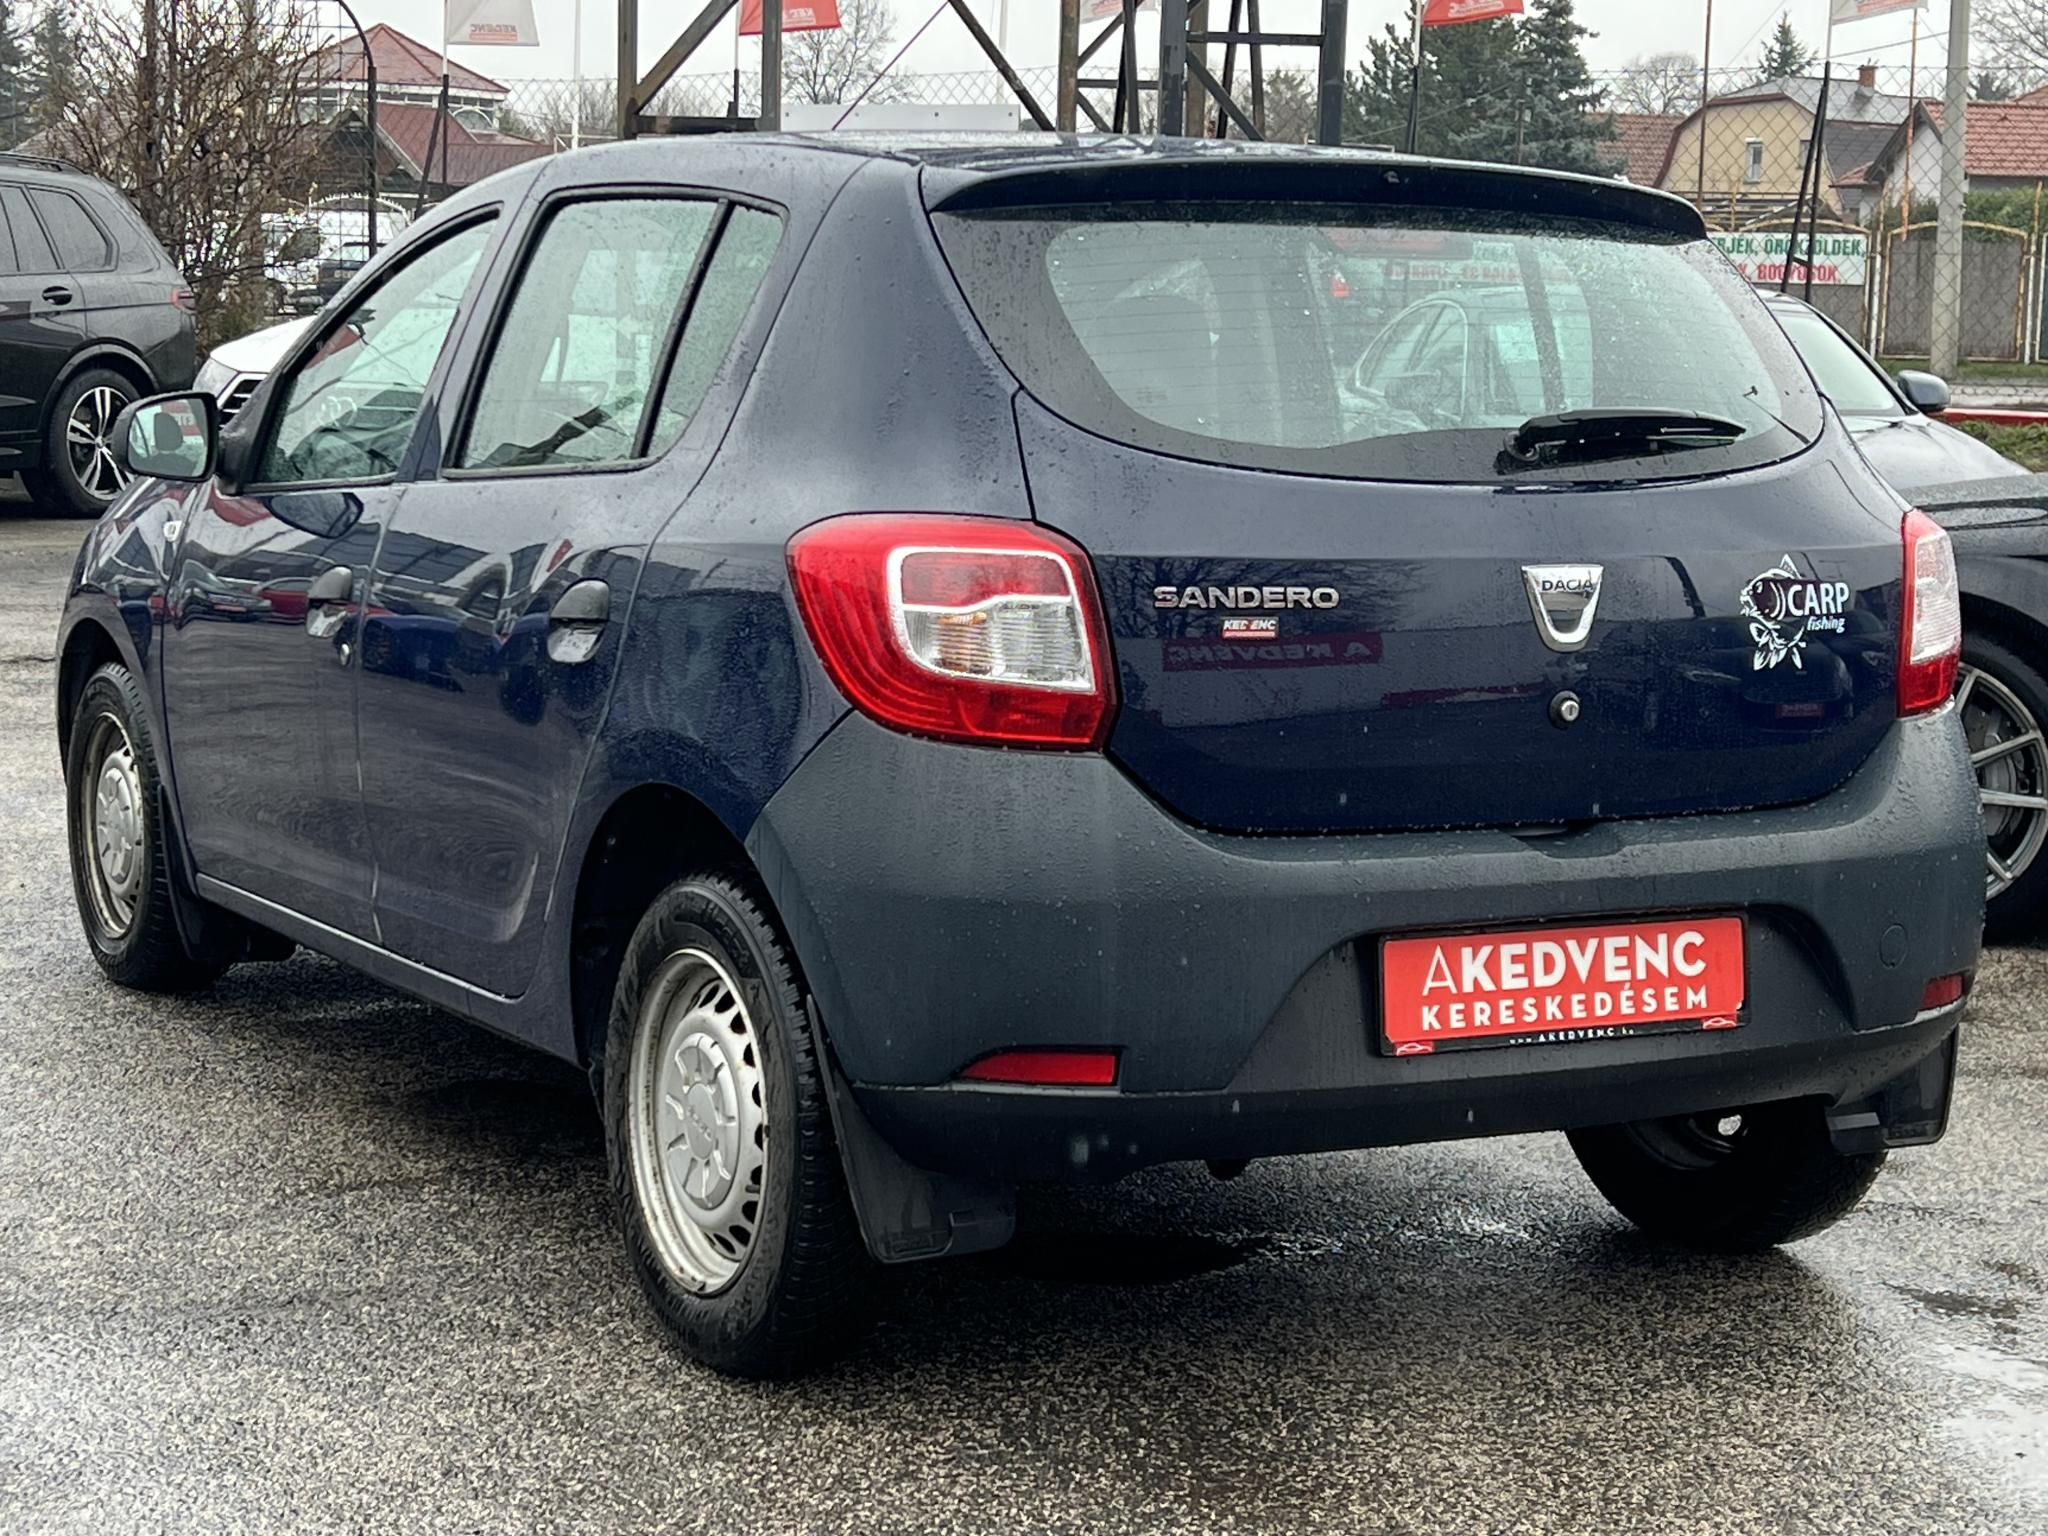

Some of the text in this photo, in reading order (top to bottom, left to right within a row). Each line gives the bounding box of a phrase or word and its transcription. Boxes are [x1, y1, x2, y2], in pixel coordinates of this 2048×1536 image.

[1712, 234, 1758, 256] RJÉK,
[1541, 579, 1594, 591] DACIA
[1153, 586, 1340, 609] SANDERO
[1787, 582, 1850, 616] CARP
[1807, 616, 1846, 634] fishing
[1422, 982, 1708, 1031] KERESKEDÉSEM
